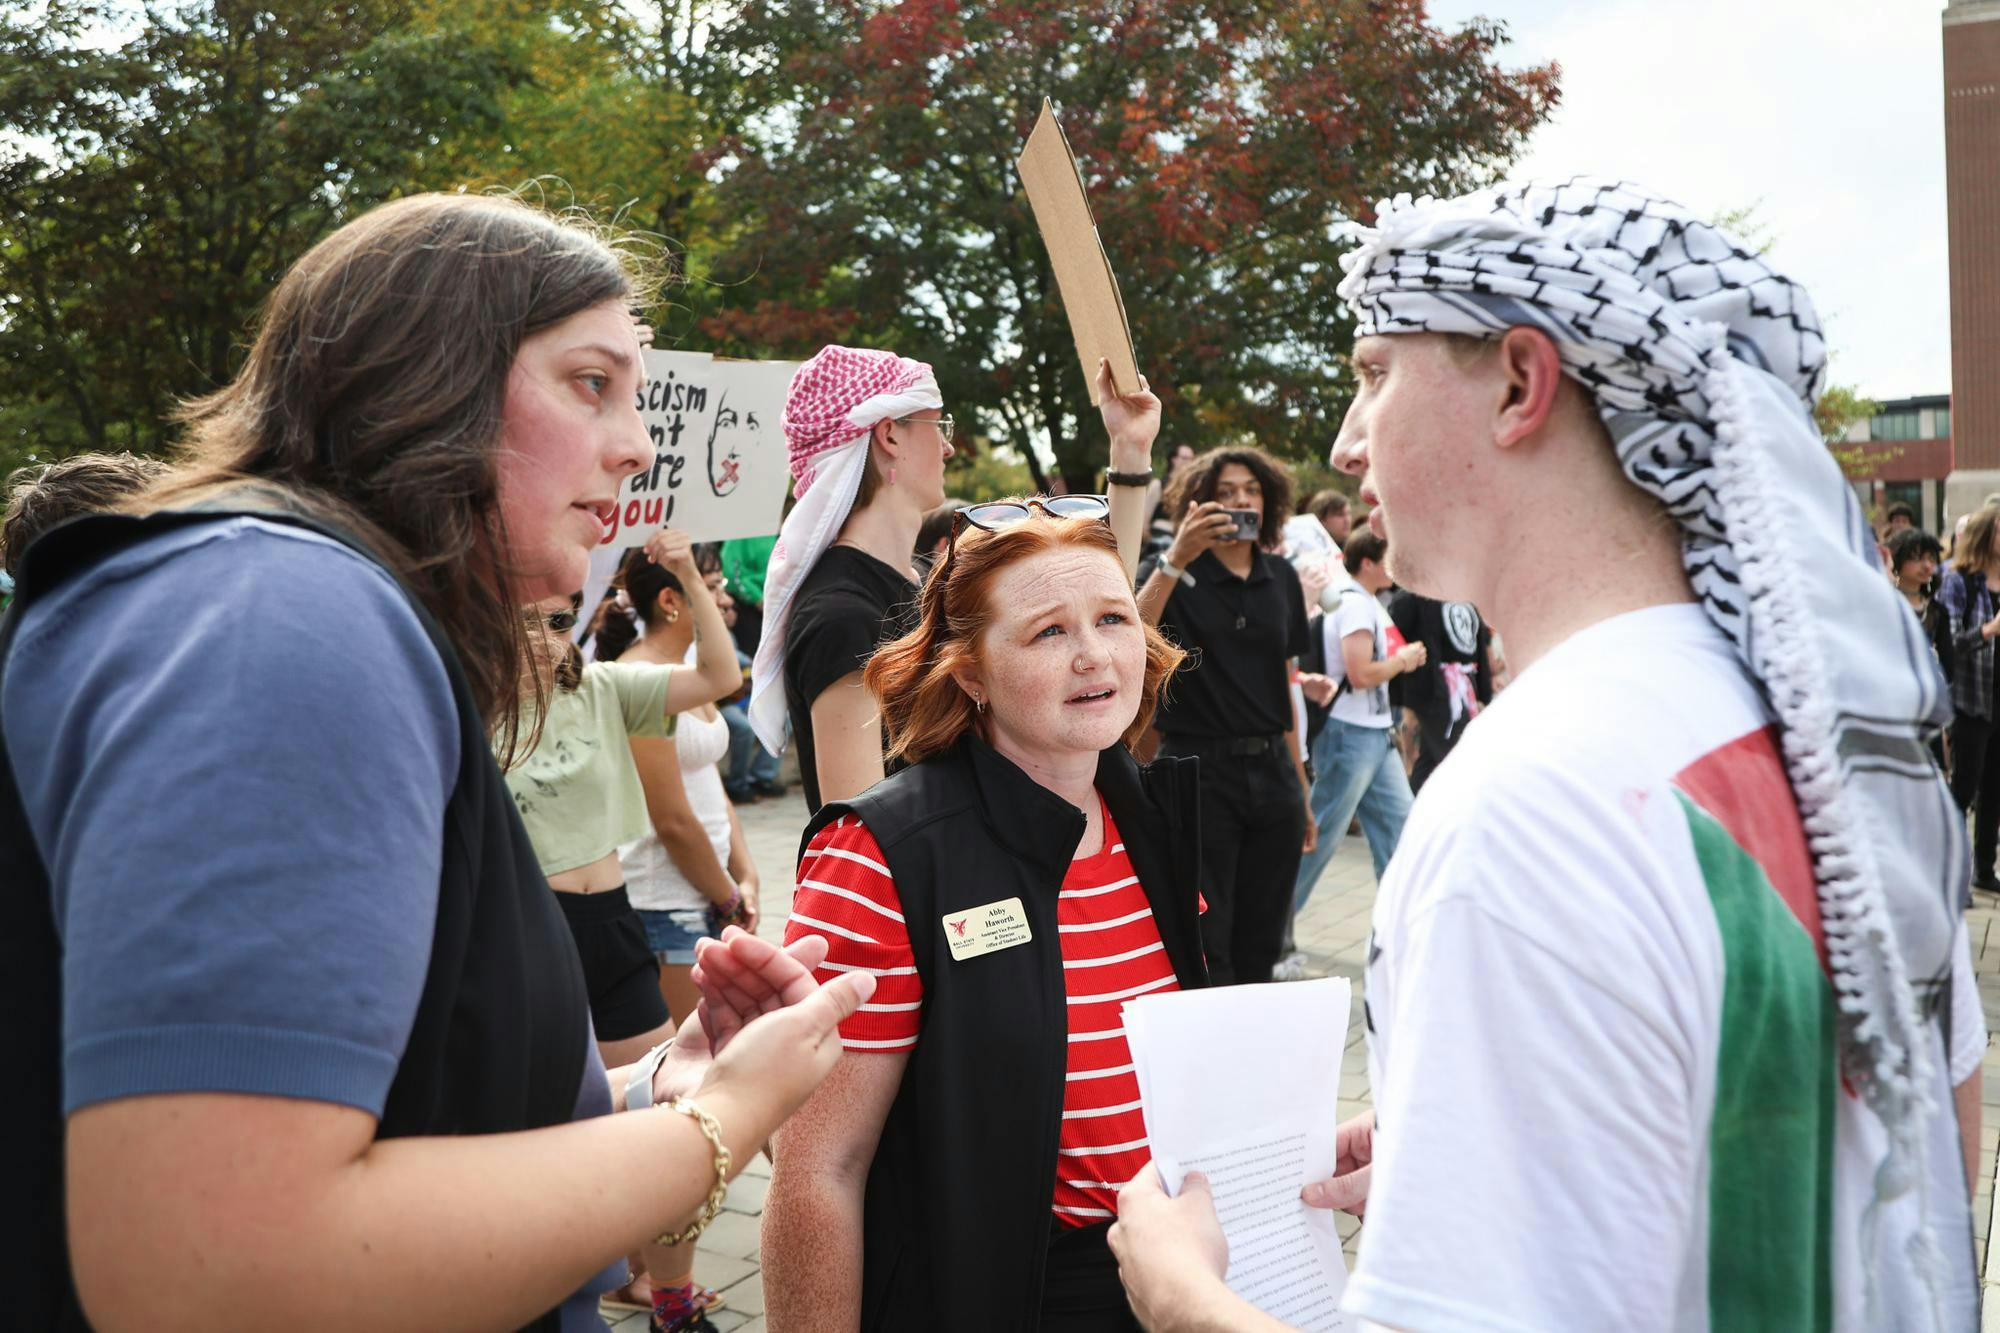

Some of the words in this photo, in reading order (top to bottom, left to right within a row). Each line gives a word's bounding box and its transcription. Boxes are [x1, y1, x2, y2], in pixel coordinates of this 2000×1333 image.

[636, 370, 707, 413] scism
[601, 495, 674, 545] you!
[985, 915, 1015, 928] Haworth
[989, 908, 1006, 917] Abby
